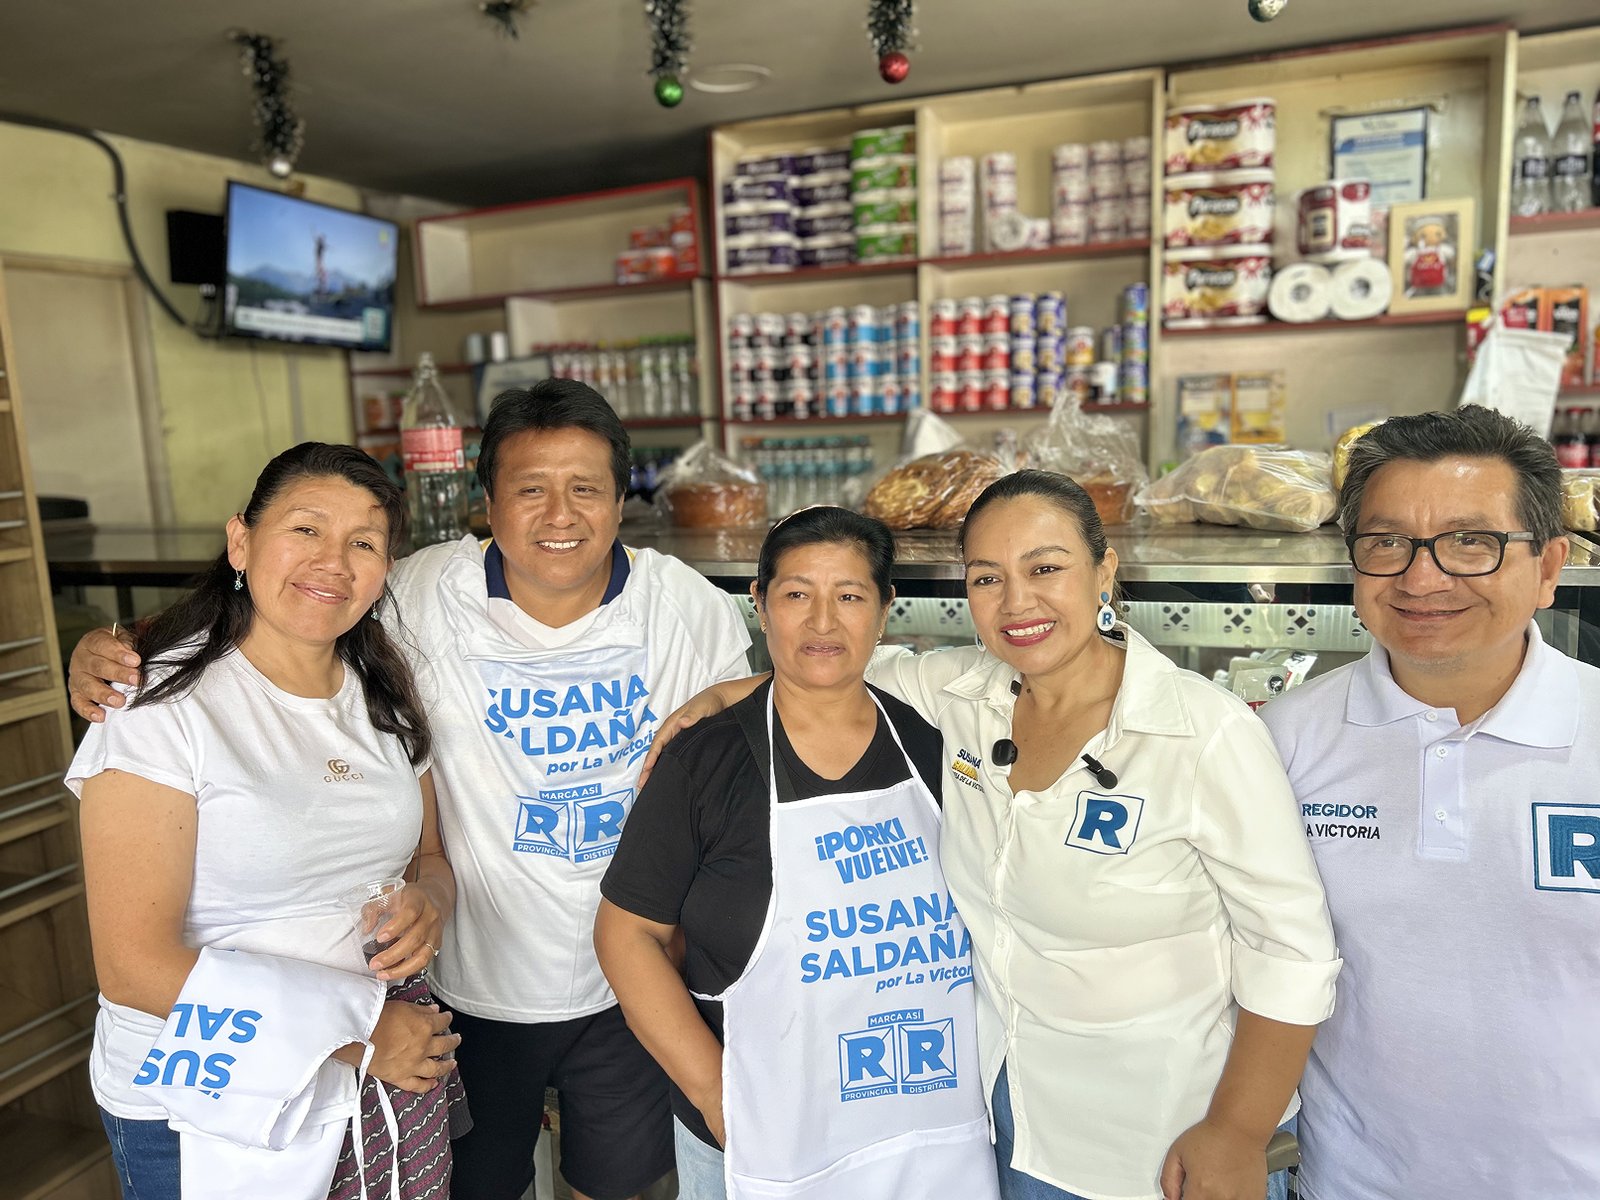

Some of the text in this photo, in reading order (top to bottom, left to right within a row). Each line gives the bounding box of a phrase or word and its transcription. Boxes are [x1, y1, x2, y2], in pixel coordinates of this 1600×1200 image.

[1103, 612, 1112, 625] R
[484, 704, 658, 756] SLDAÑA
[546, 730, 656, 775] por La Victori
[324, 772, 364, 783] GUCCI
[541, 785, 599, 800] MARCA ASÍ
[1077, 798, 1129, 849] R
[1302, 803, 1378, 819] REGIDOR
[524, 801, 625, 851] R R
[815, 817, 906, 861] ¡PORKI
[1316, 824, 1381, 840] VICTORIA
[517, 844, 617, 861] PROVINCIA DISTRIT
[835, 836, 929, 884] VUELVE!
[1548, 814, 1600, 879] R
[876, 965, 973, 993] por La Victor
[870, 1009, 922, 1025] MARCA ASÍ
[848, 1028, 946, 1081] R R
[845, 1081, 949, 1100] PROVINCIAL DISTRITAL
